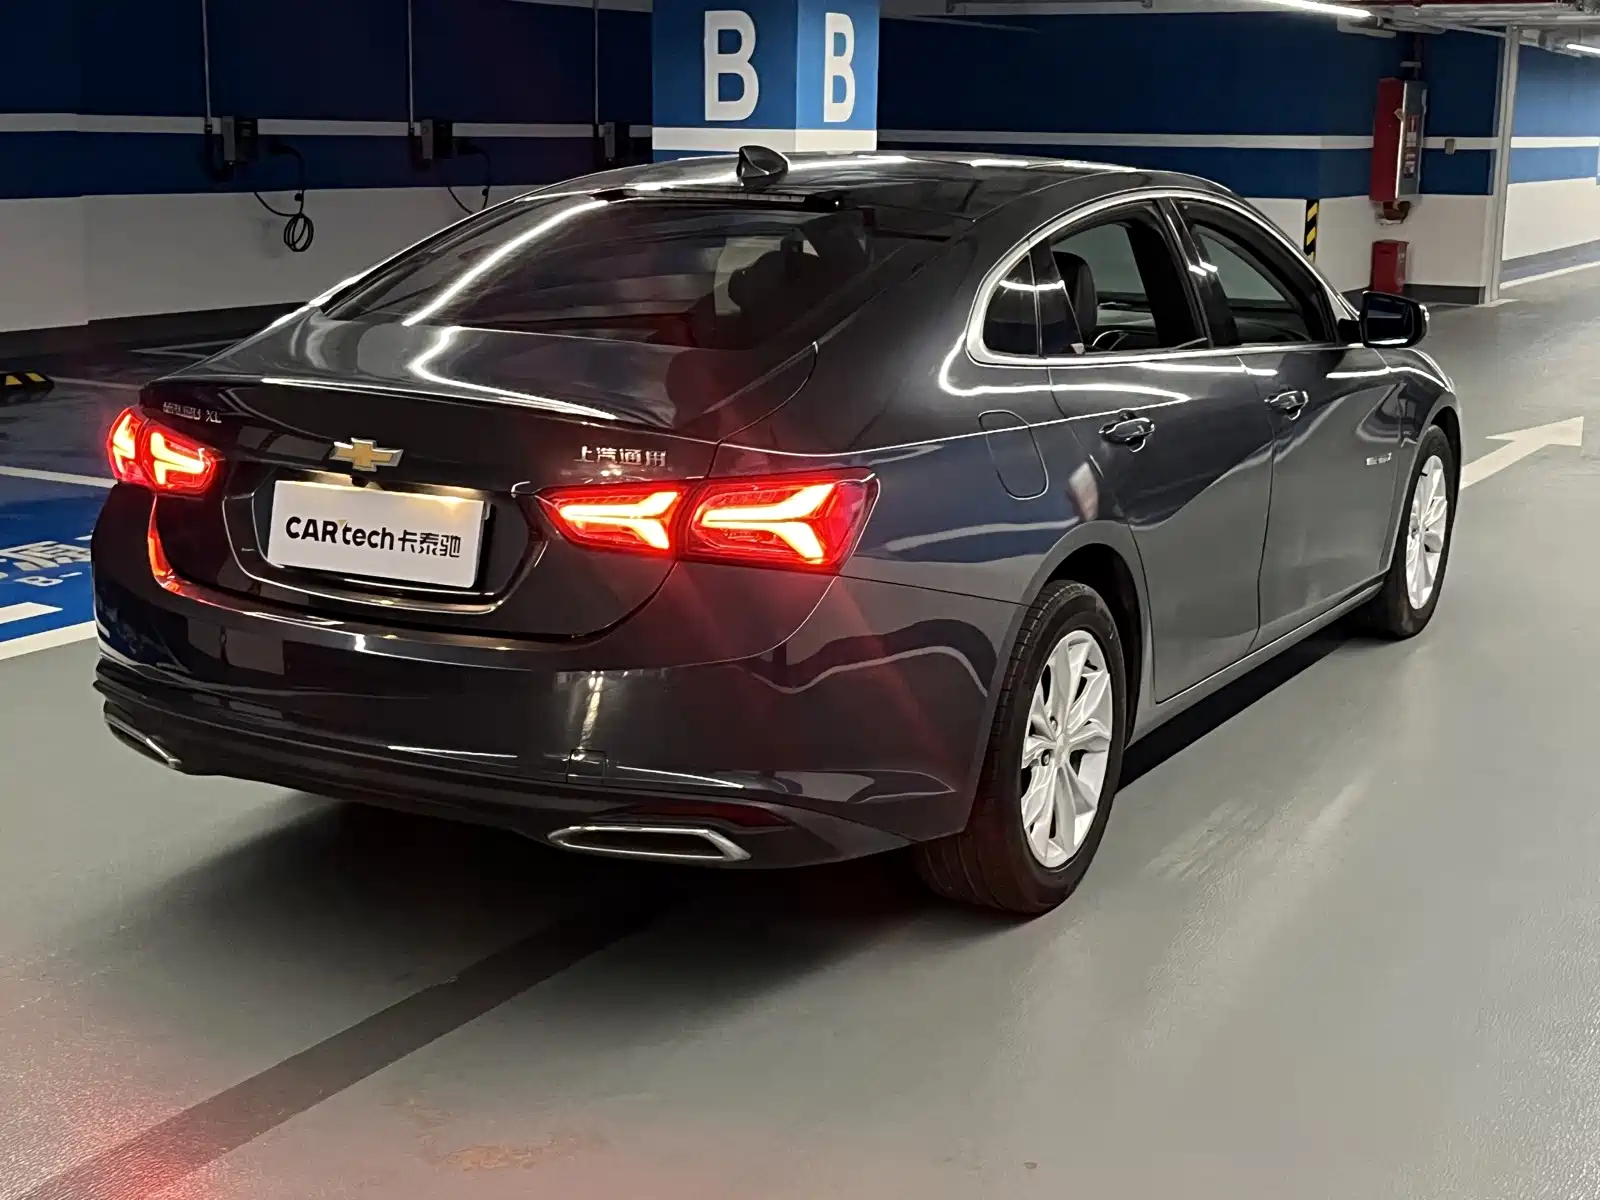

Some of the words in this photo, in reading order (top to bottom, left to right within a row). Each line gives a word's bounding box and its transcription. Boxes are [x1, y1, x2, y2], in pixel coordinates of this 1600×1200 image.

[704, 10, 759, 121] B
[823, 12, 856, 123] B
[573, 445, 667, 467] 上汽通用
[285, 516, 395, 551] CARtech
[397, 529, 462, 558] 卡泰驰
